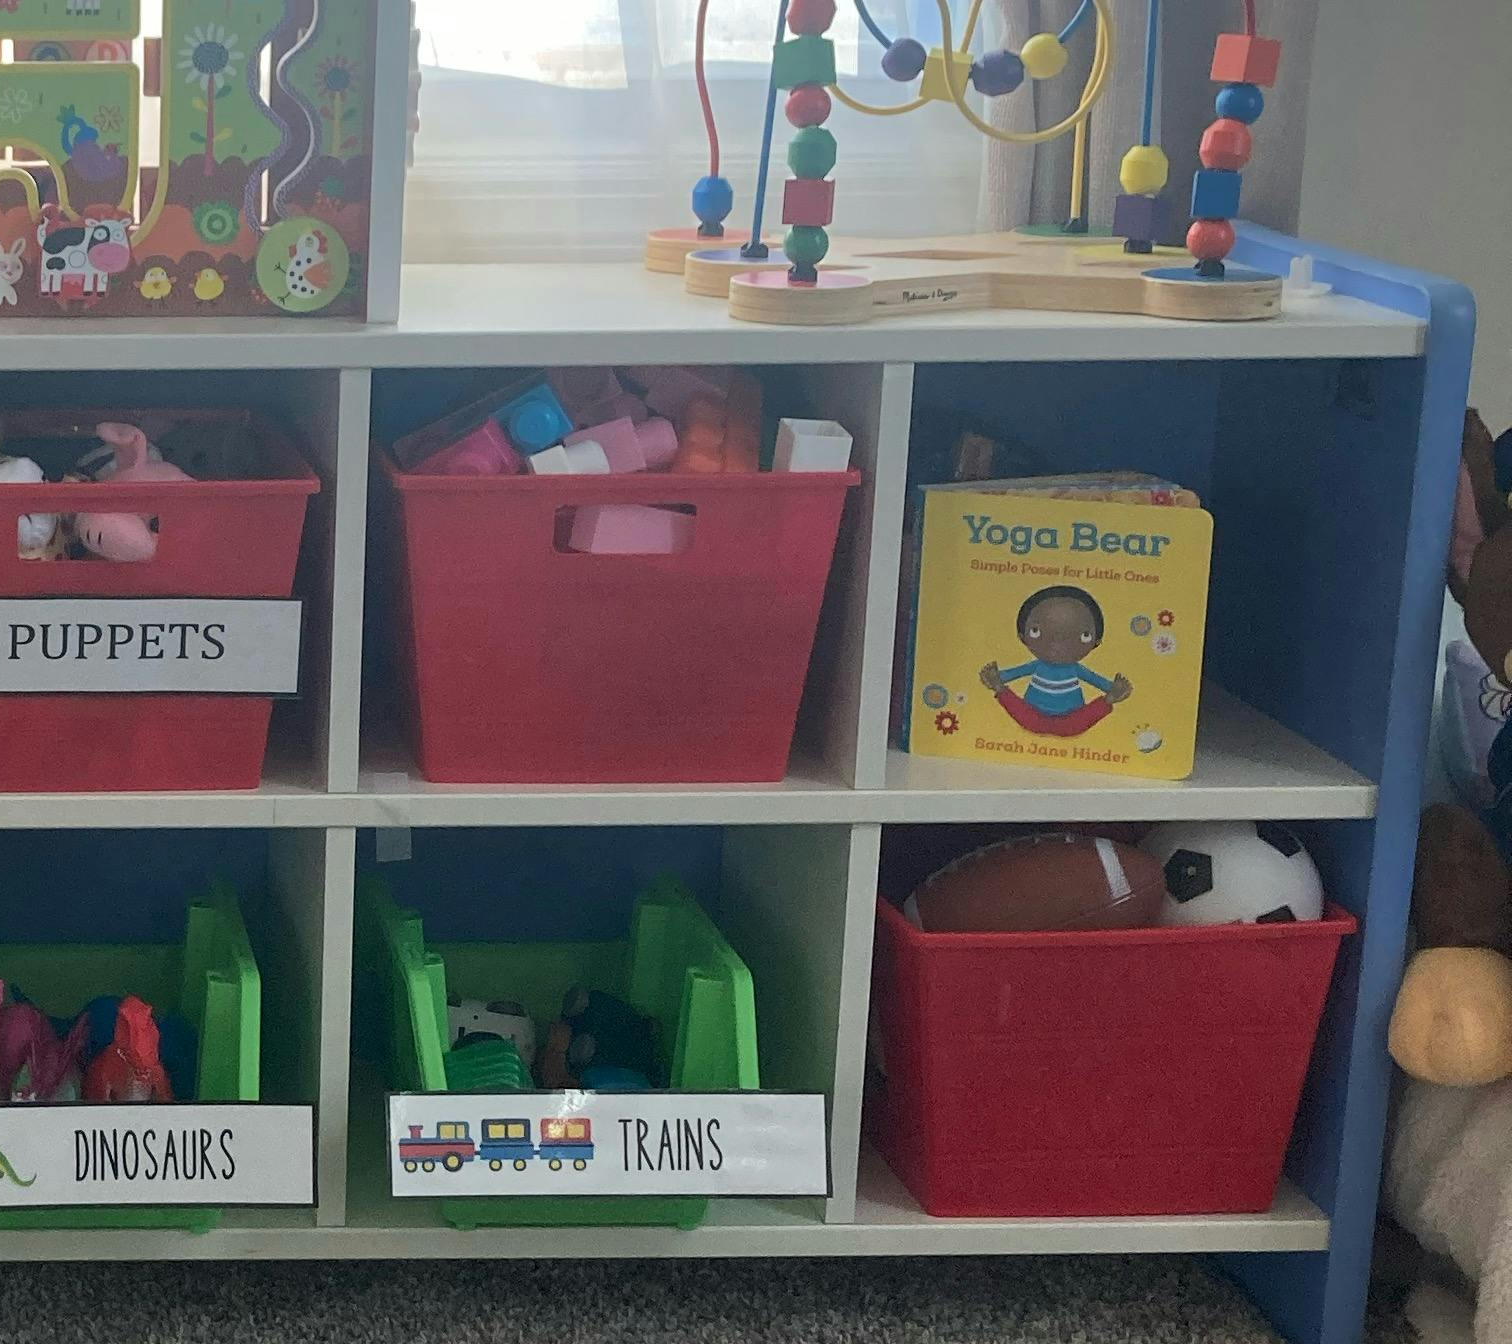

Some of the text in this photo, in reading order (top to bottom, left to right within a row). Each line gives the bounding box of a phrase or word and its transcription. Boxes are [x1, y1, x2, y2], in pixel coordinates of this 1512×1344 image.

[962, 513, 1171, 557] Yoga Bear
[970, 559, 1161, 584] Simple Poses for Little Ones
[7, 623, 226, 660] PUPPETS
[974, 737, 1131, 764] Sarah Jane Hinder
[74, 1128, 236, 1182] DINOSAURS
[617, 1117, 724, 1172] TRAINS
